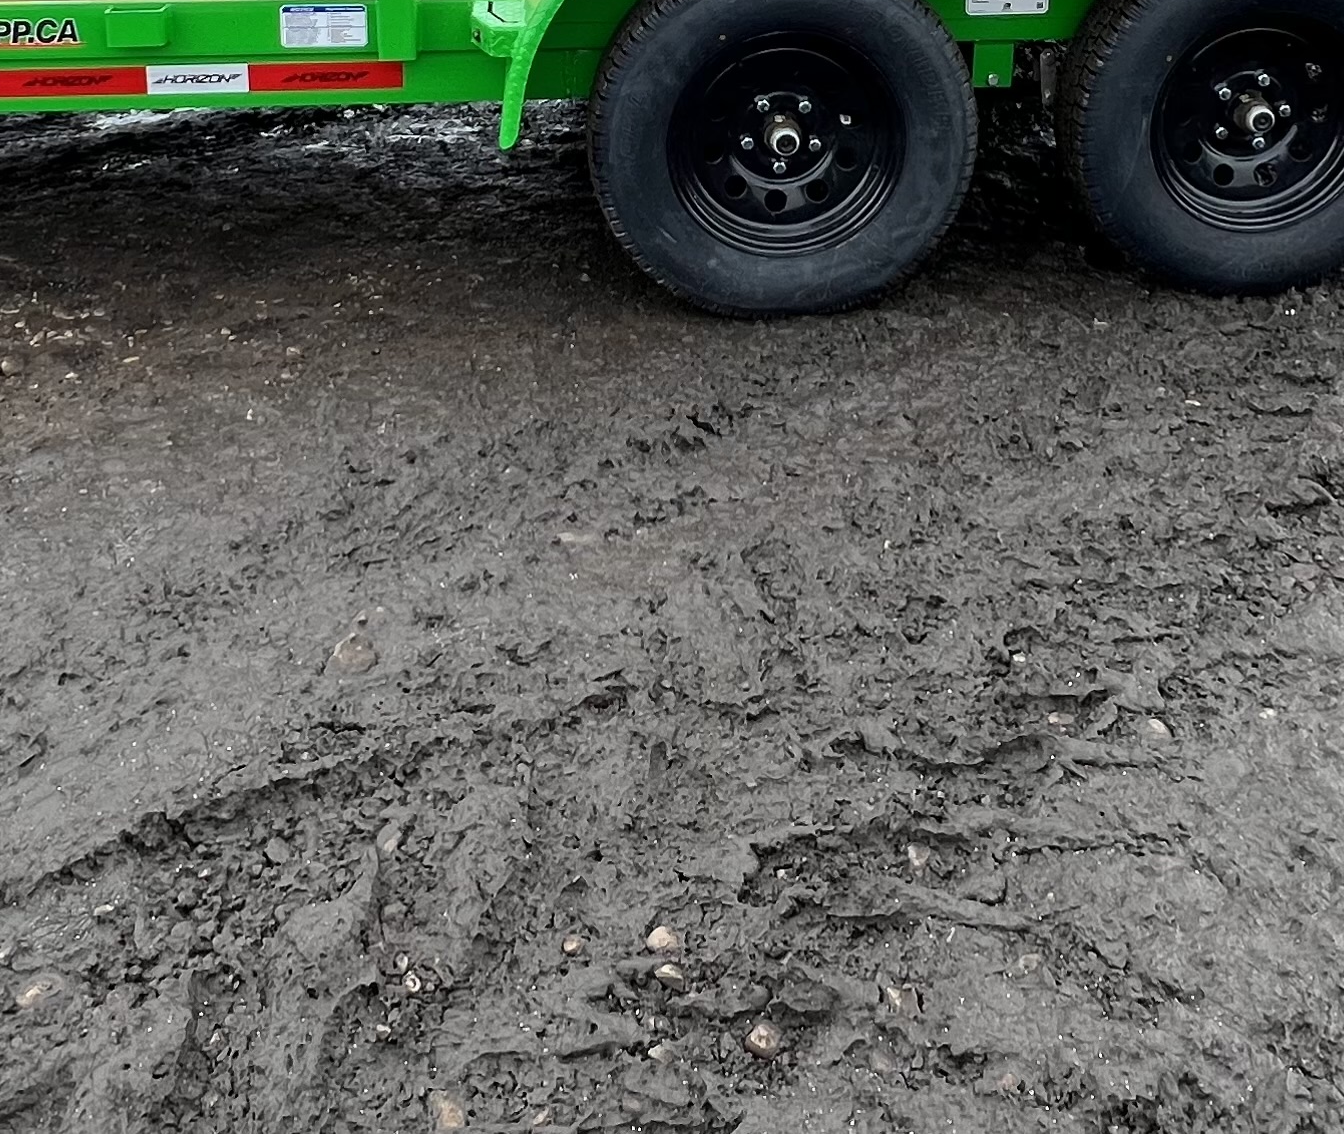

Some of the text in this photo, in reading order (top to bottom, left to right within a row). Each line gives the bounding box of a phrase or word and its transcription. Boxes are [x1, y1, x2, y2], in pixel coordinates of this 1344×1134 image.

[30, 74, 105, 88] HORIZON
[160, 72, 233, 85] HORIZON
[290, 70, 364, 83] HORIZON
